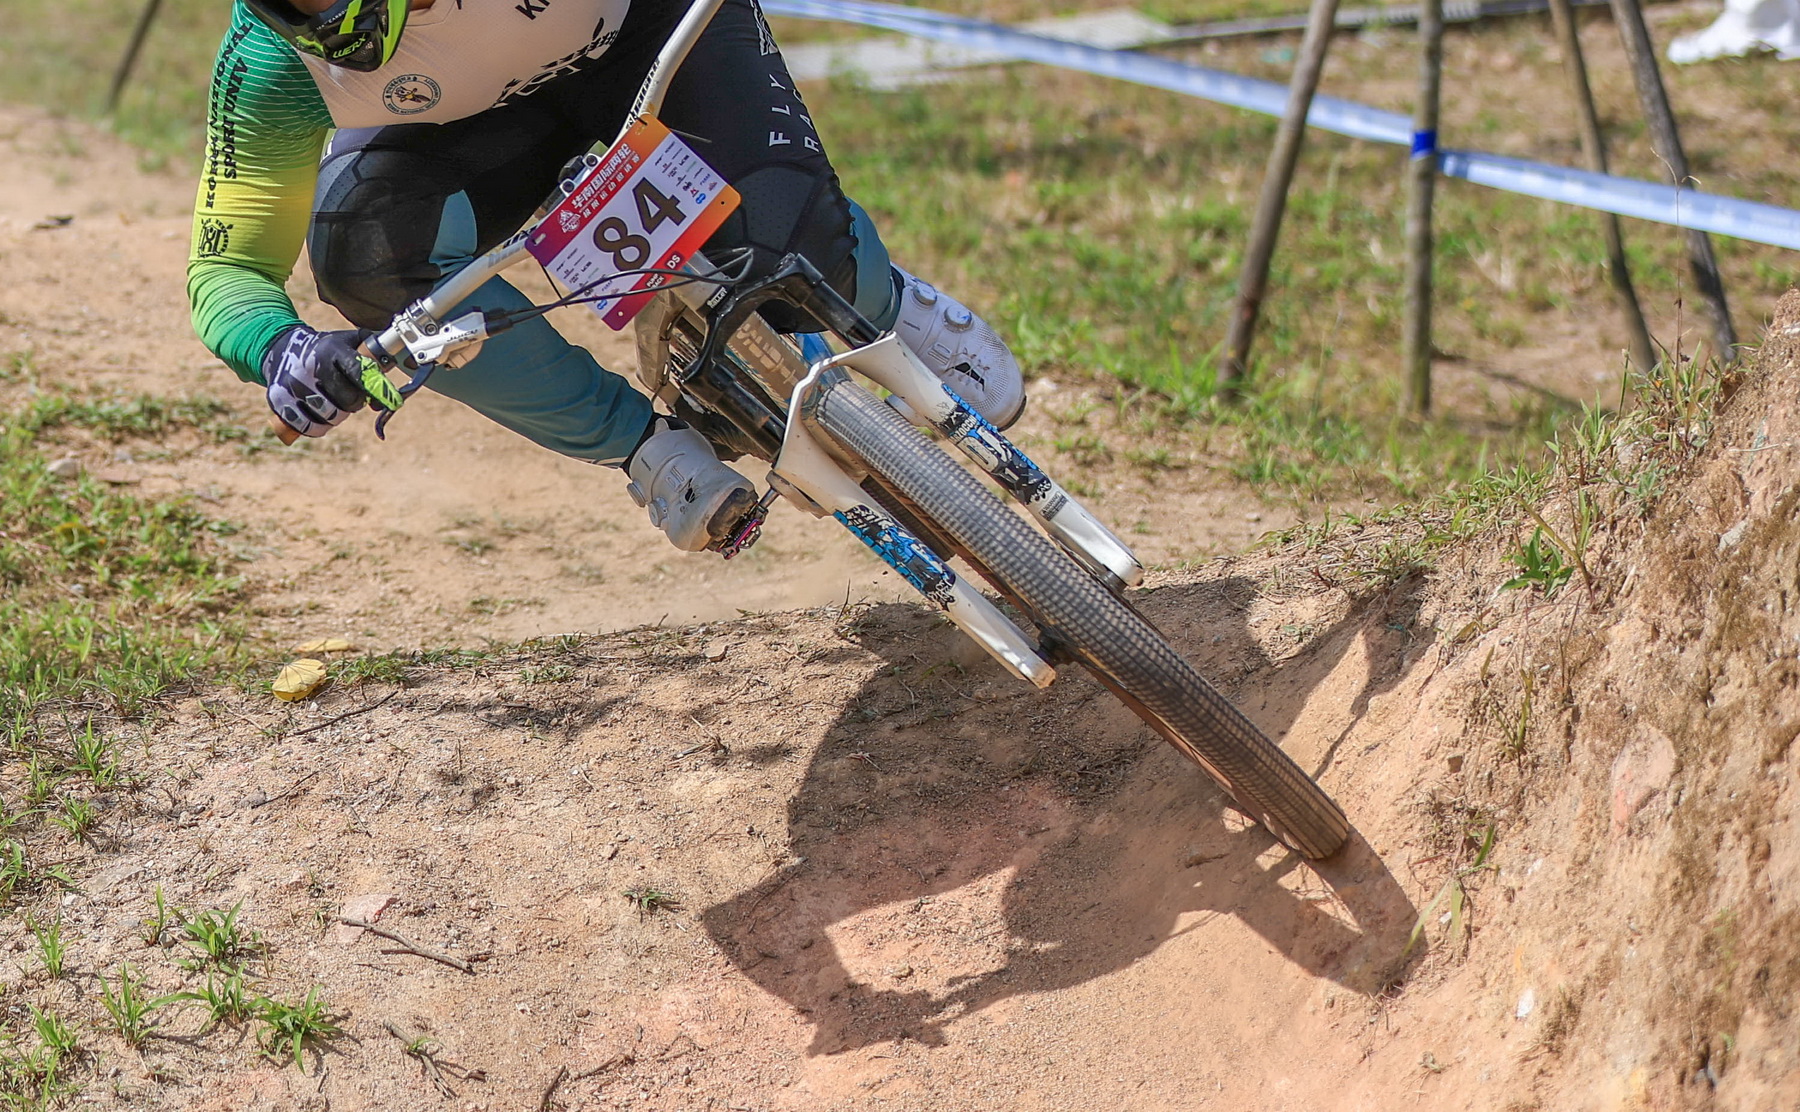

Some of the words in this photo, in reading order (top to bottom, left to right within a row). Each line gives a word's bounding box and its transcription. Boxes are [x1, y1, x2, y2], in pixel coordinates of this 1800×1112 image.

[332, 33, 367, 59] WERX
[223, 56, 249, 113] UNIV
[768, 73, 792, 147] FLY
[205, 136, 221, 209] KOREA
[221, 115, 238, 180] SPORT
[571, 143, 632, 210] 华南国际两轮
[593, 177, 687, 272] 84
[646, 272, 659, 288] PUMP
[650, 275, 666, 289] RACK
[666, 254, 681, 269] DS
